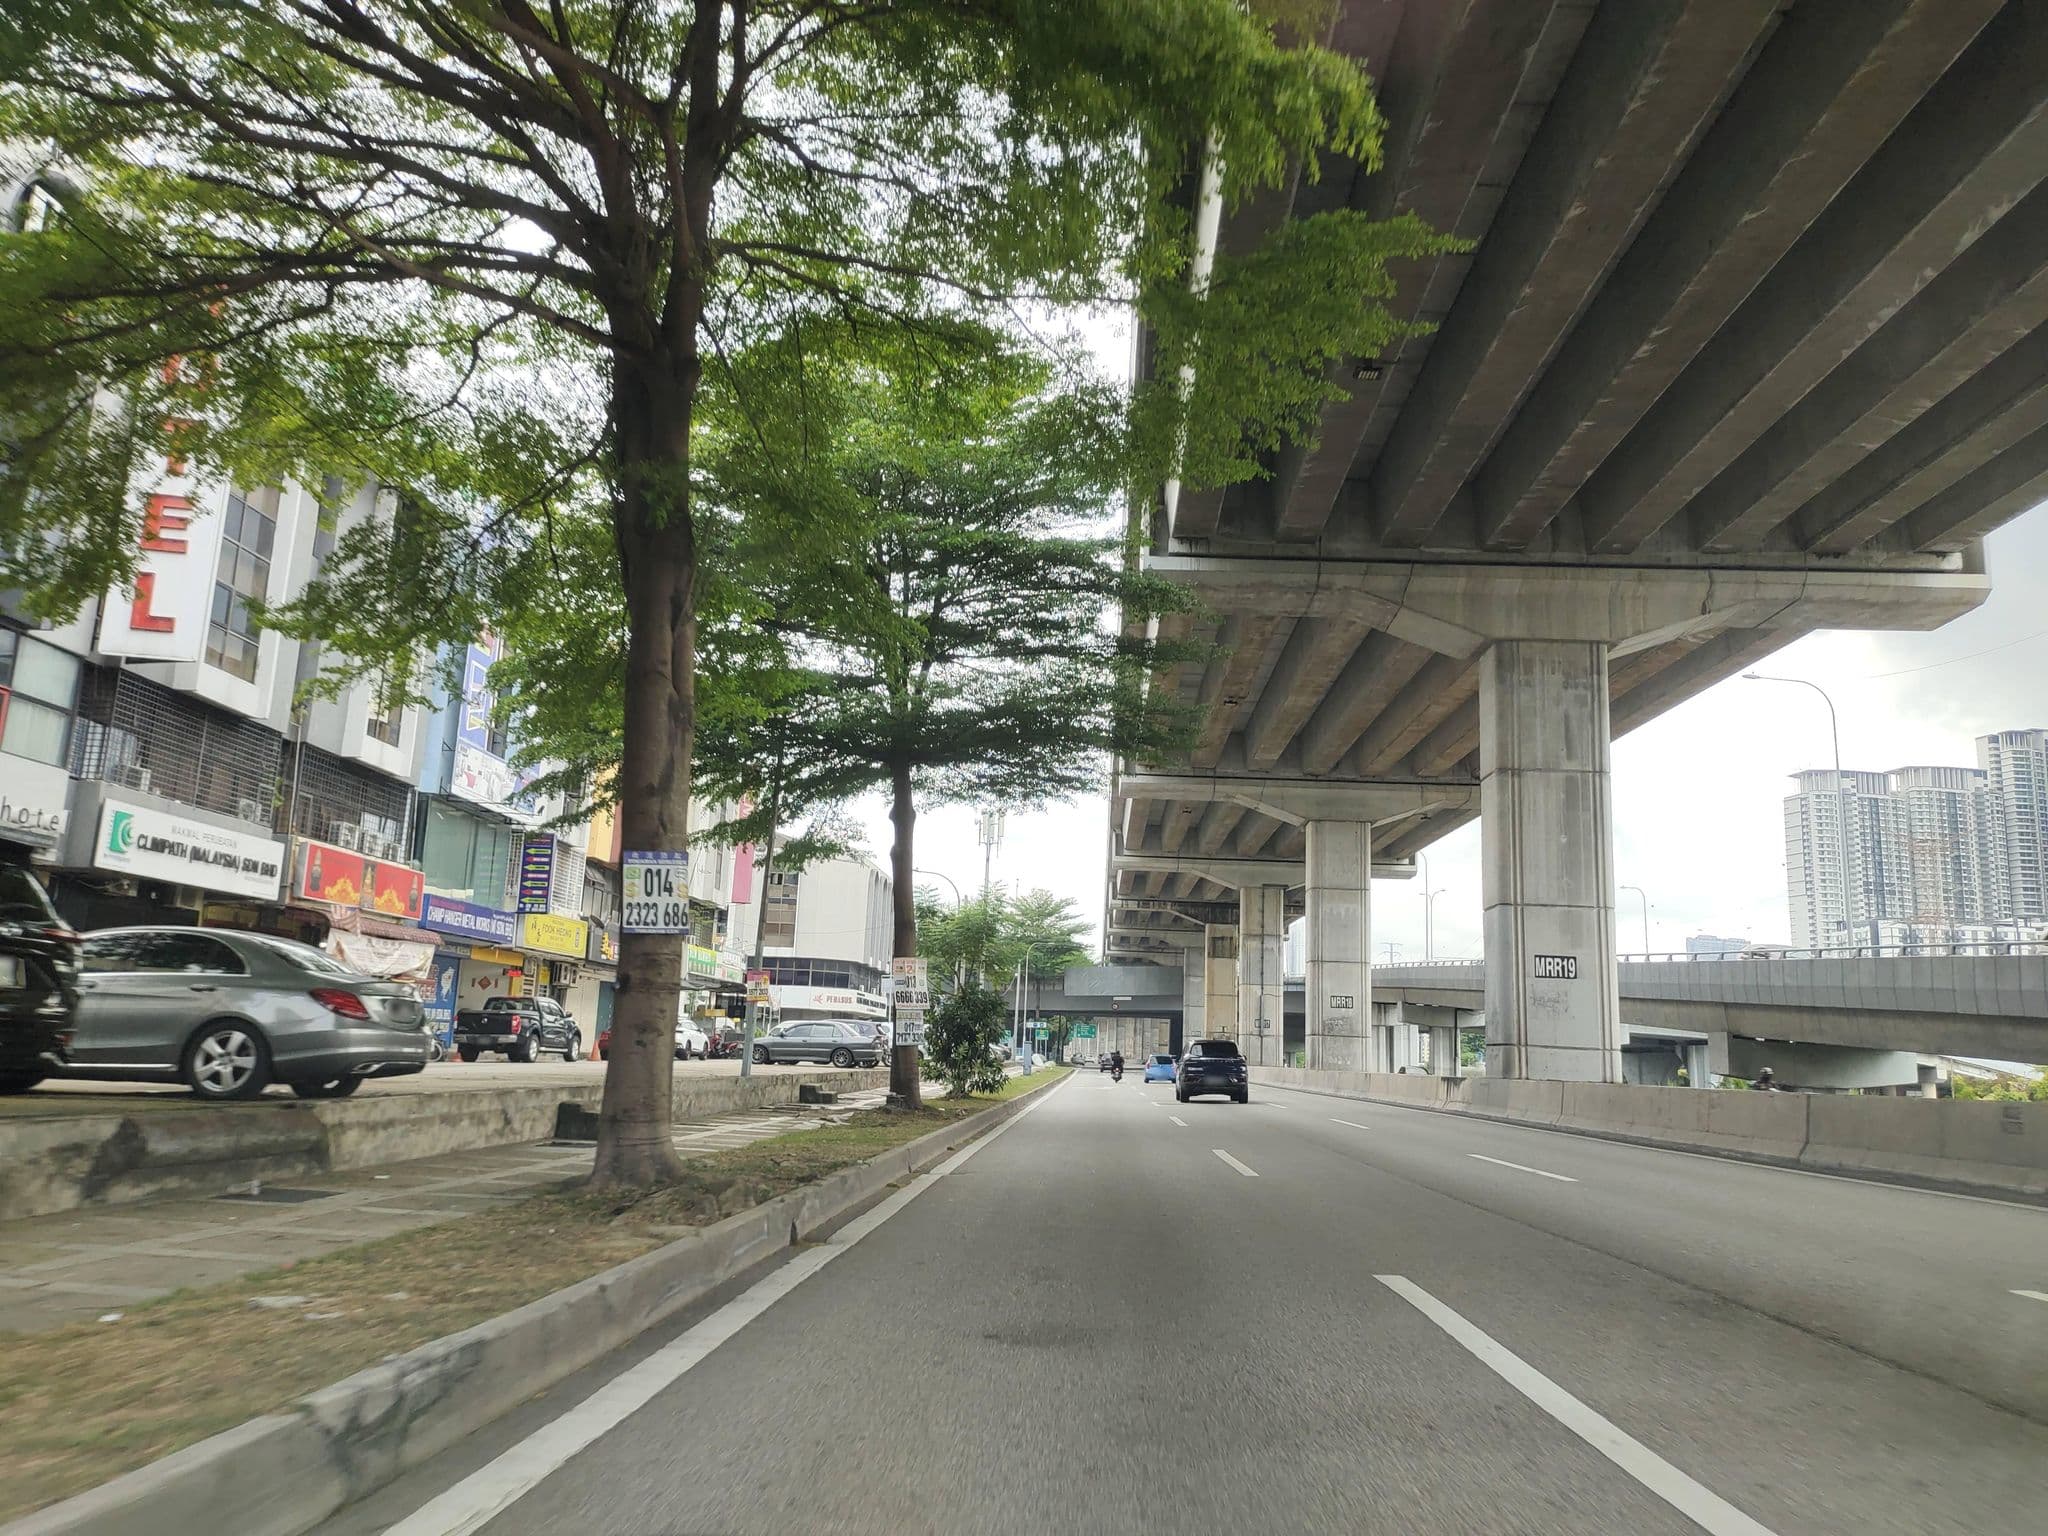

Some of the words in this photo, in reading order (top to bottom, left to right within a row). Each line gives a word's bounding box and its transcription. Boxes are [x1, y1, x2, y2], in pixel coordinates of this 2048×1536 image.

[644, 868, 674, 897] 014
[626, 902, 658, 926] 2323
[663, 902, 688, 927] 686
[1535, 957, 1576, 978] MRR19
